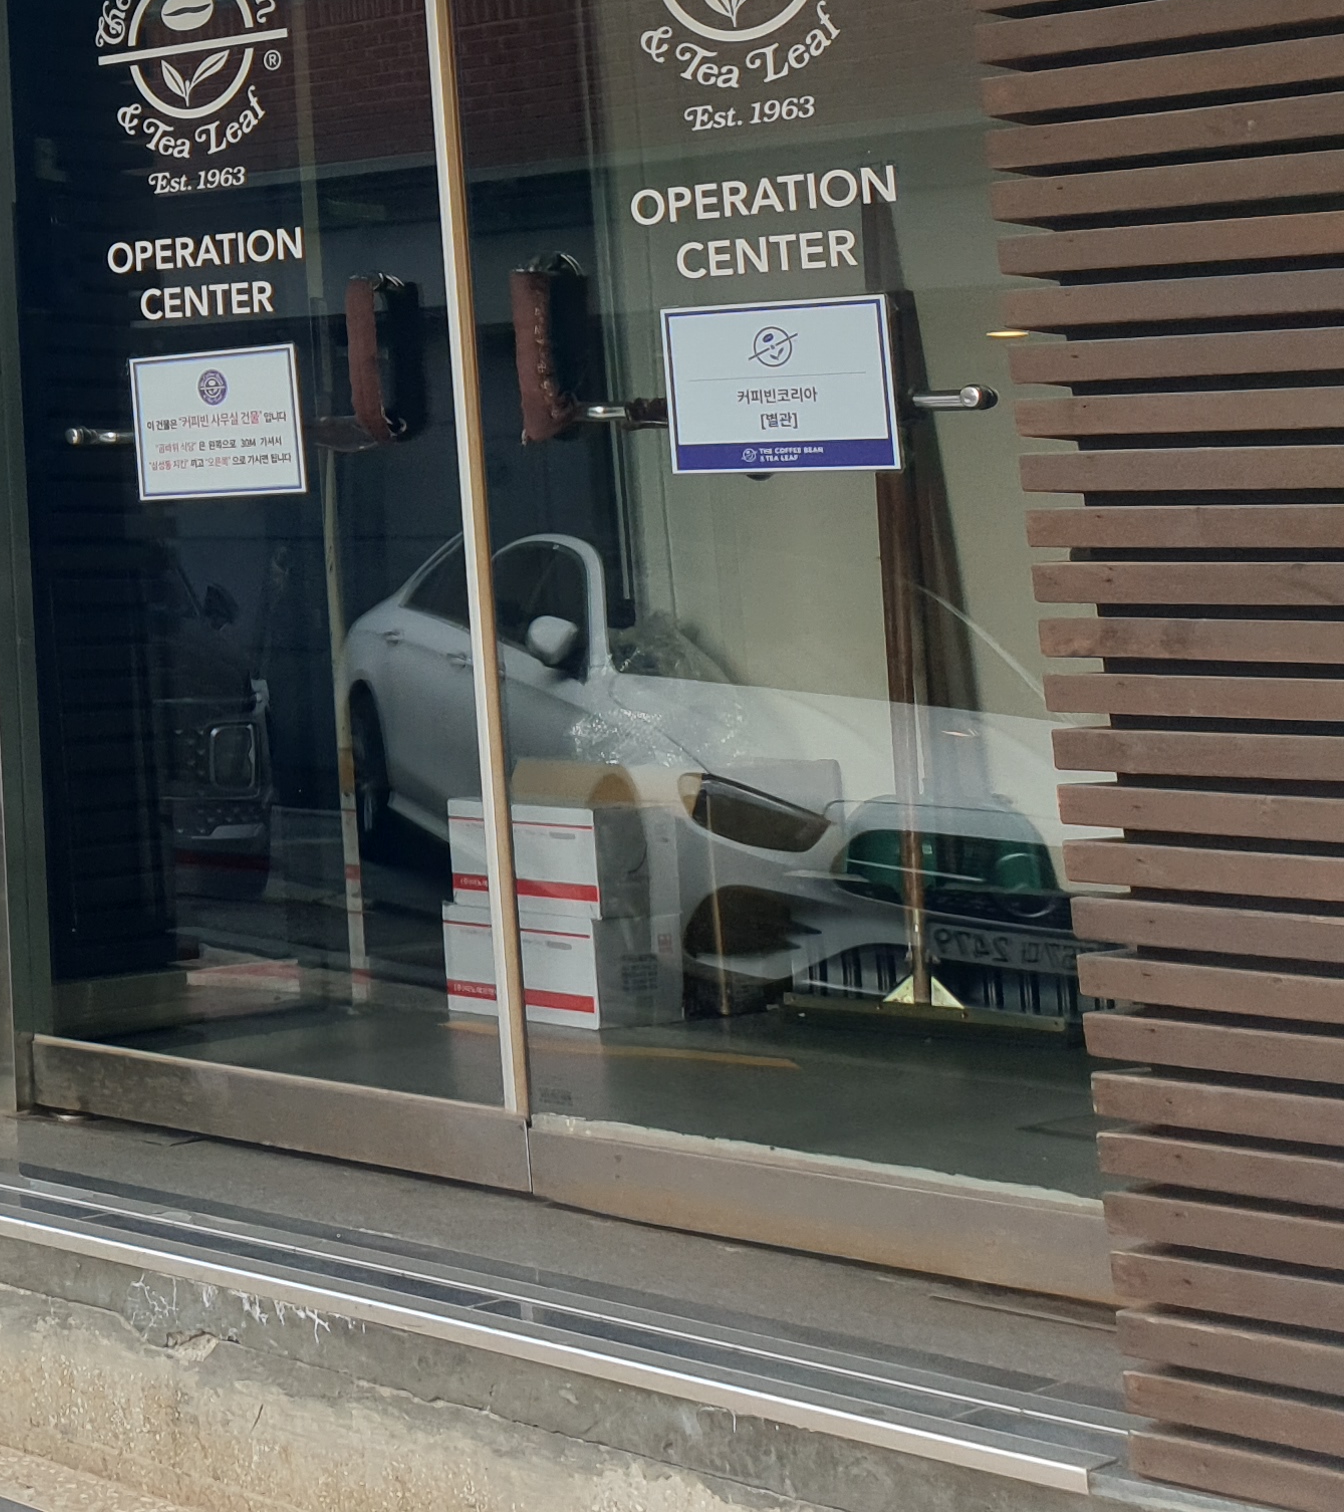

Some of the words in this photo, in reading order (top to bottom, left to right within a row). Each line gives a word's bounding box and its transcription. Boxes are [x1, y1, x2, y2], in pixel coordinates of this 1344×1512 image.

[641, 26, 673, 63] &
[676, 43, 740, 88] Tea
[745, 0, 842, 83] Leaf
[117, 103, 142, 134] &
[143, 118, 190, 158] Tea
[195, 85, 266, 157] Leaf
[684, 103, 742, 131] Est.
[750, 95, 815, 125] 1963
[148, 170, 192, 195] Est.
[196, 166, 245, 190] 1963
[630, 164, 898, 226] OPERATION
[107, 226, 303, 274] OPERATION
[675, 229, 858, 279] CENTER
[140, 280, 274, 321] CENTER
[737, 386, 819, 405] 커피빈코리아
[156, 418, 178, 431] 건물은
[211, 412, 240, 427] 사무실
[263, 410, 287, 423] 입니다
